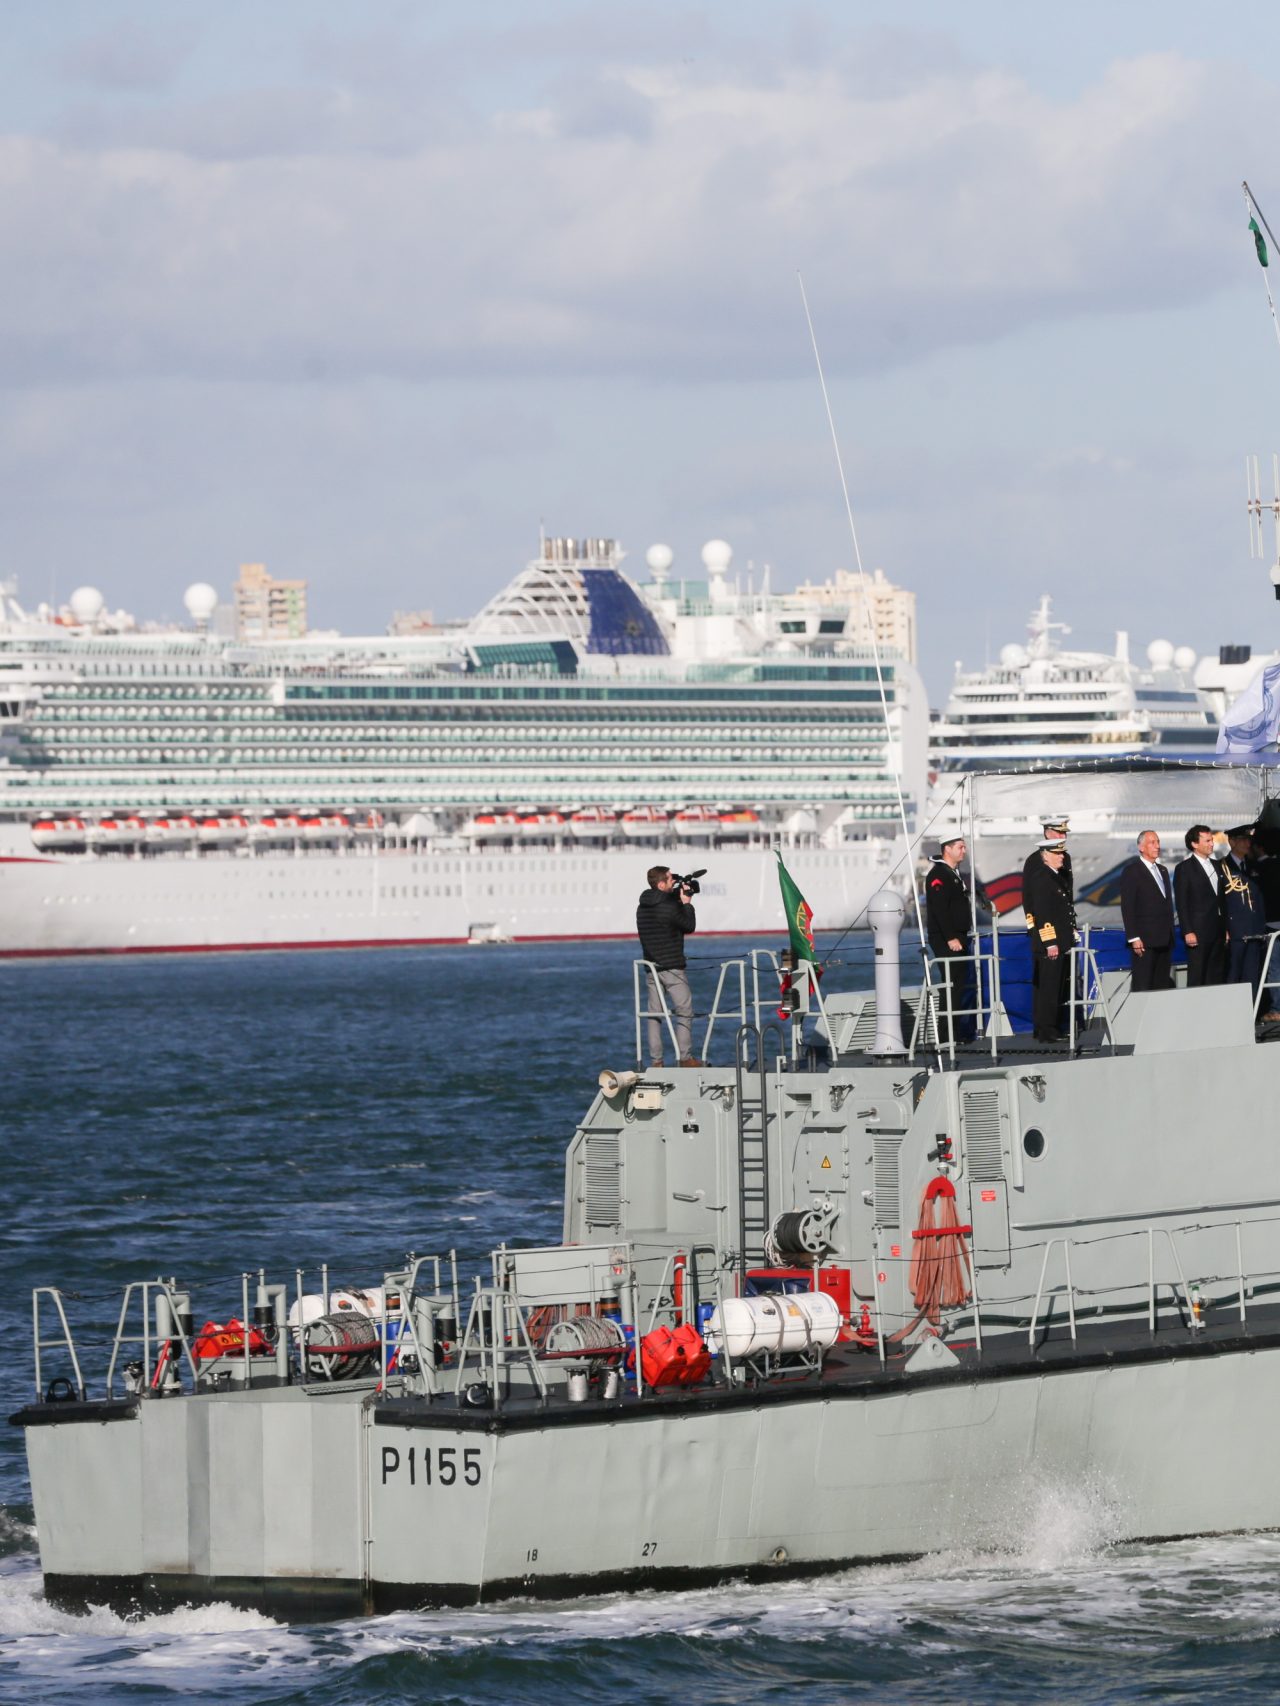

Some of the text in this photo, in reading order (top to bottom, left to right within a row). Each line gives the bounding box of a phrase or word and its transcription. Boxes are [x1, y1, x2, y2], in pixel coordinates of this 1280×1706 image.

[382, 1446, 481, 1486] P1155
[526, 1549, 539, 1562] 18
[642, 1542, 657, 1557] 27
